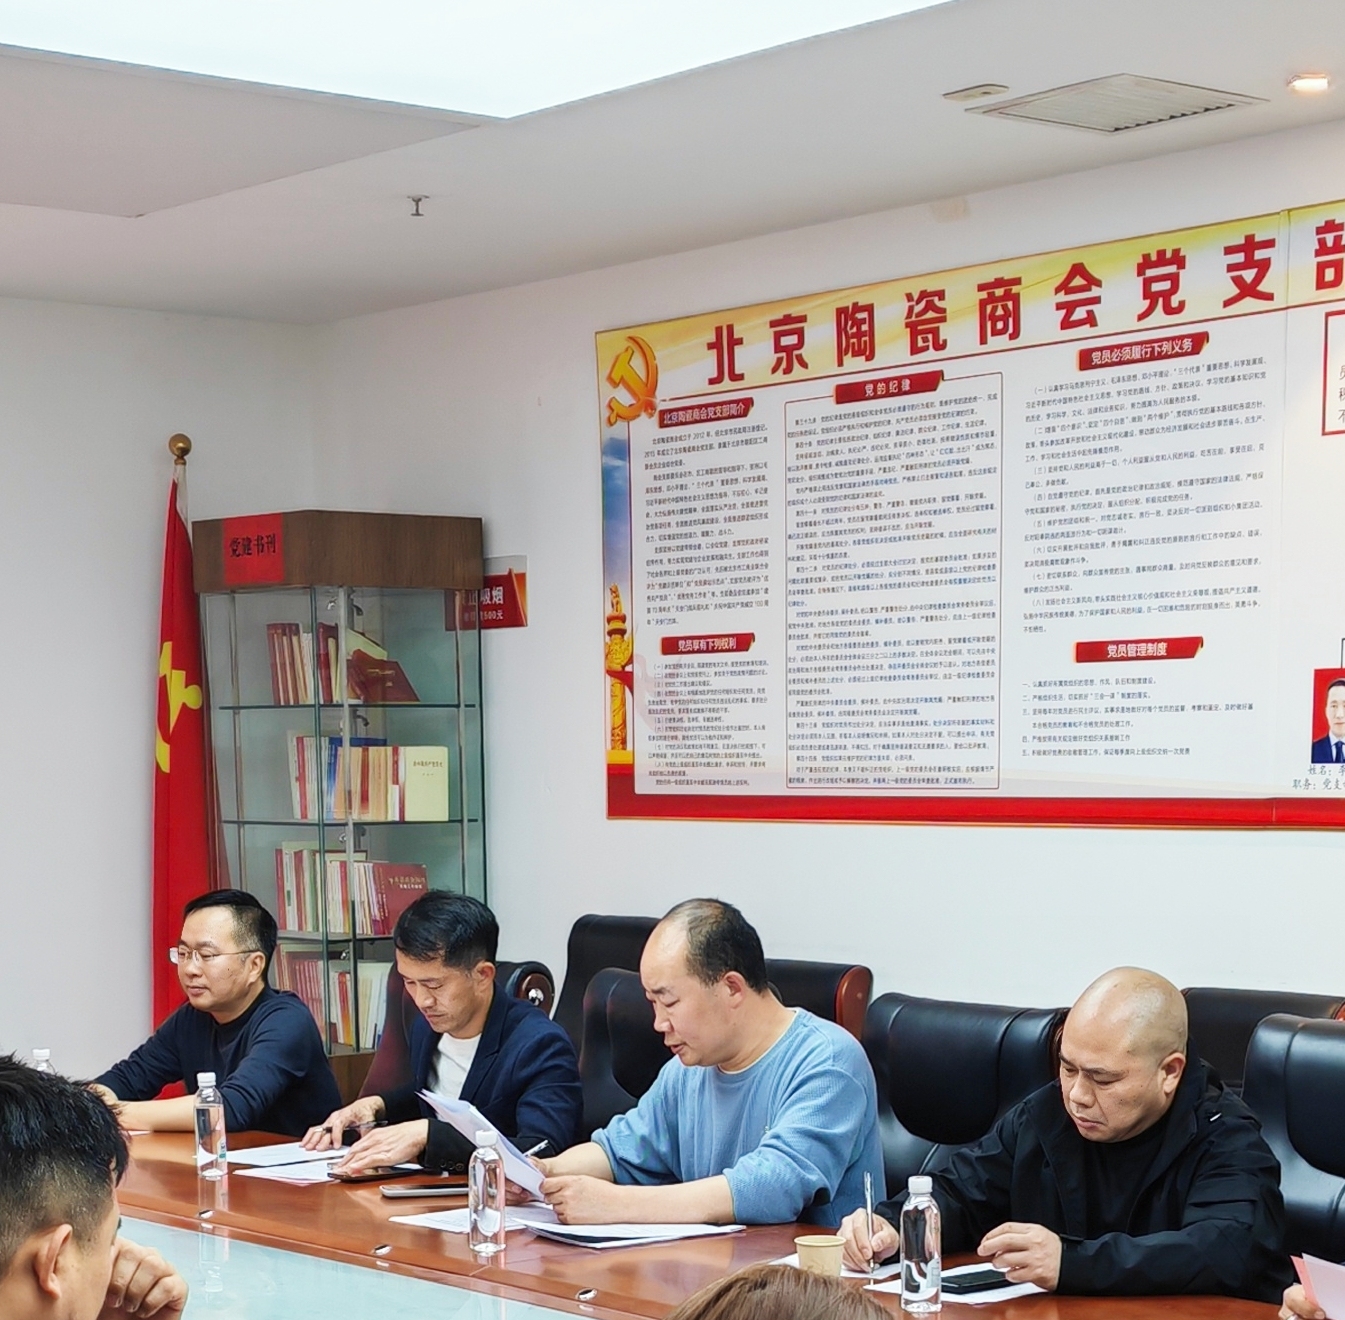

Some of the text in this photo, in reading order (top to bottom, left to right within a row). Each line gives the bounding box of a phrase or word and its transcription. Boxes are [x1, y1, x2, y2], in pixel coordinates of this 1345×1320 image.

[1092, 338, 1193, 366] 党员必须履行下列义务
[865, 379, 911, 397] 党的纪律
[229, 533, 277, 558] 党建书刊
[461, 586, 504, 605] 止吸烟
[1107, 642, 1167, 658] 党员管理制度
